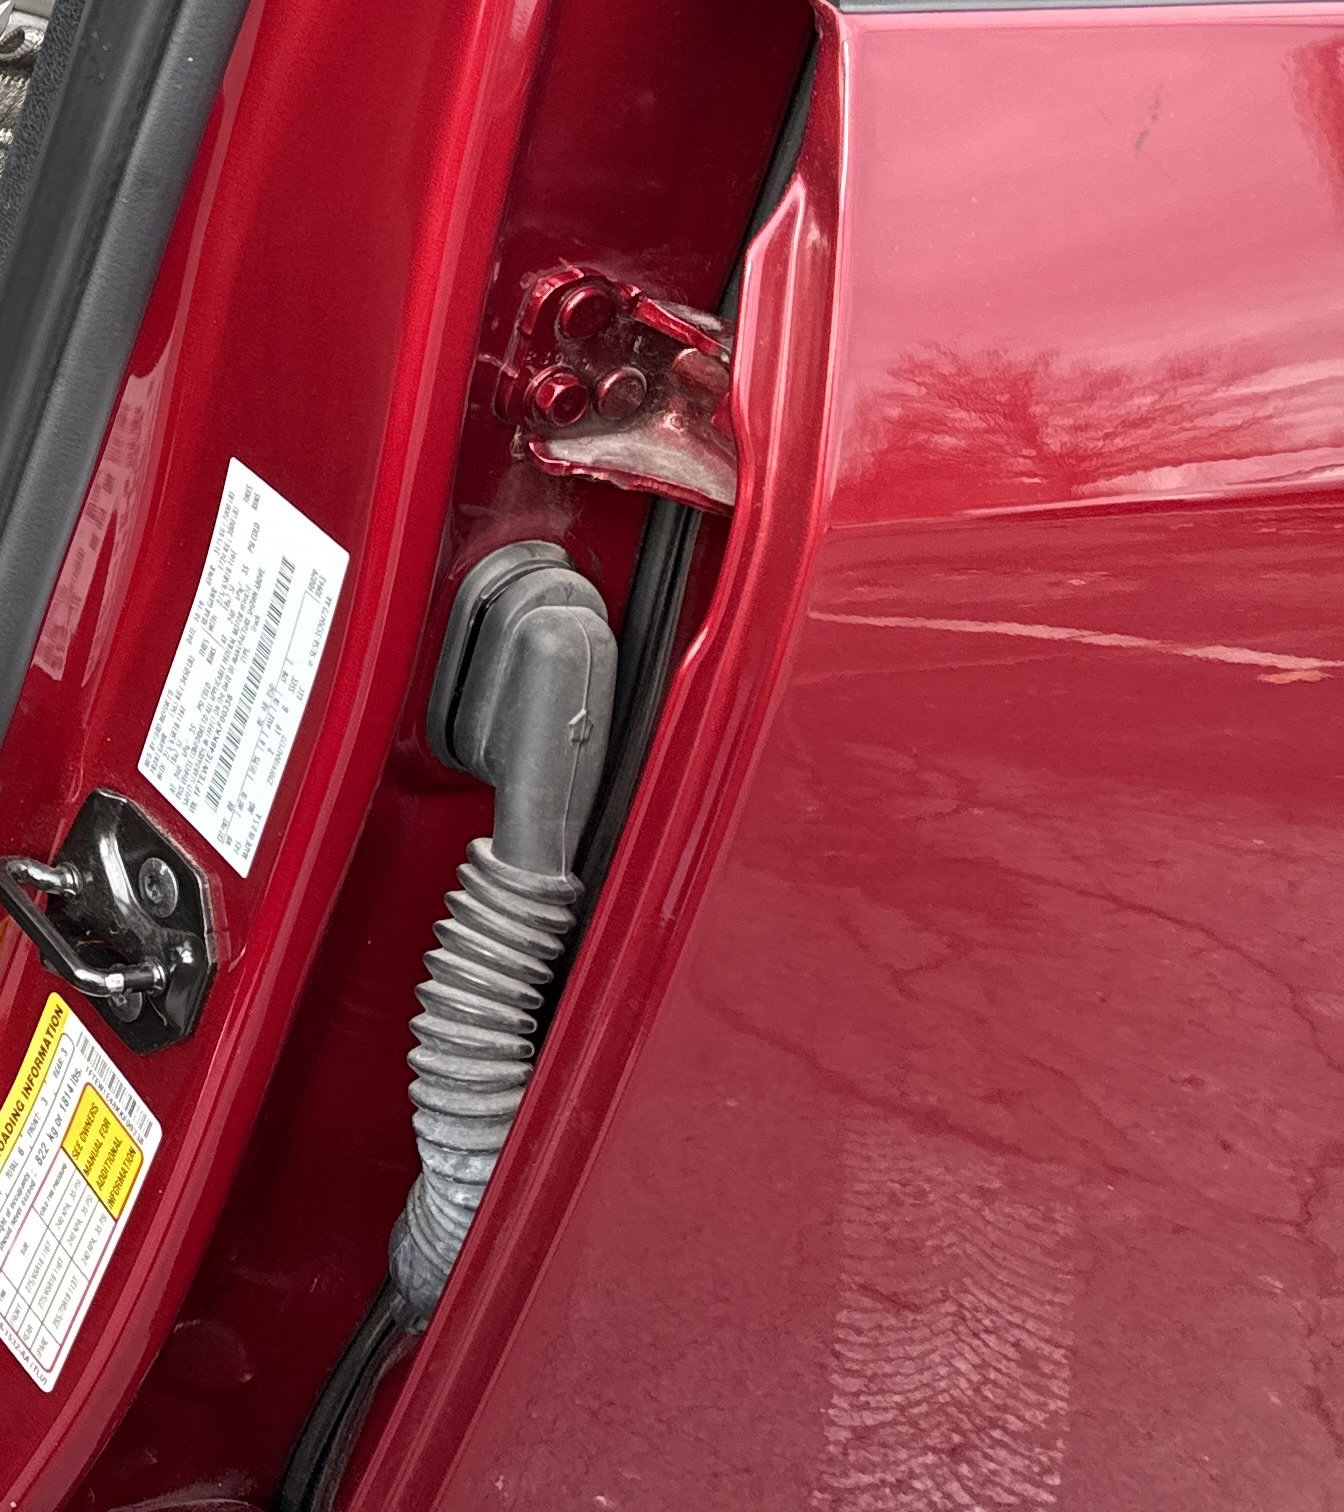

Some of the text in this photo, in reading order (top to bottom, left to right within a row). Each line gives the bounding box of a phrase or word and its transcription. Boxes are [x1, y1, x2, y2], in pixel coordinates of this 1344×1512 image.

[17, 1003, 66, 1100] INFORMATION
[40, 1095, 48, 1106] 3
[60, 1045, 68, 1057] 3
[54, 1112, 63, 1127] or
[58, 1082, 75, 1113] 1814
[34, 1139, 49, 1167] 822
[45, 1123, 58, 1144] kg
[70, 1100, 100, 1161] SEE OWNERS
[82, 1115, 111, 1177] MANUAL FOR
[94, 1133, 122, 1191] ADDITIONAL
[105, 1145, 136, 1209] INFORMATION
[4, 1206, 12, 1218] of
[9, 1169, 30, 1211] occupants
[10, 1204, 22, 1228] never
